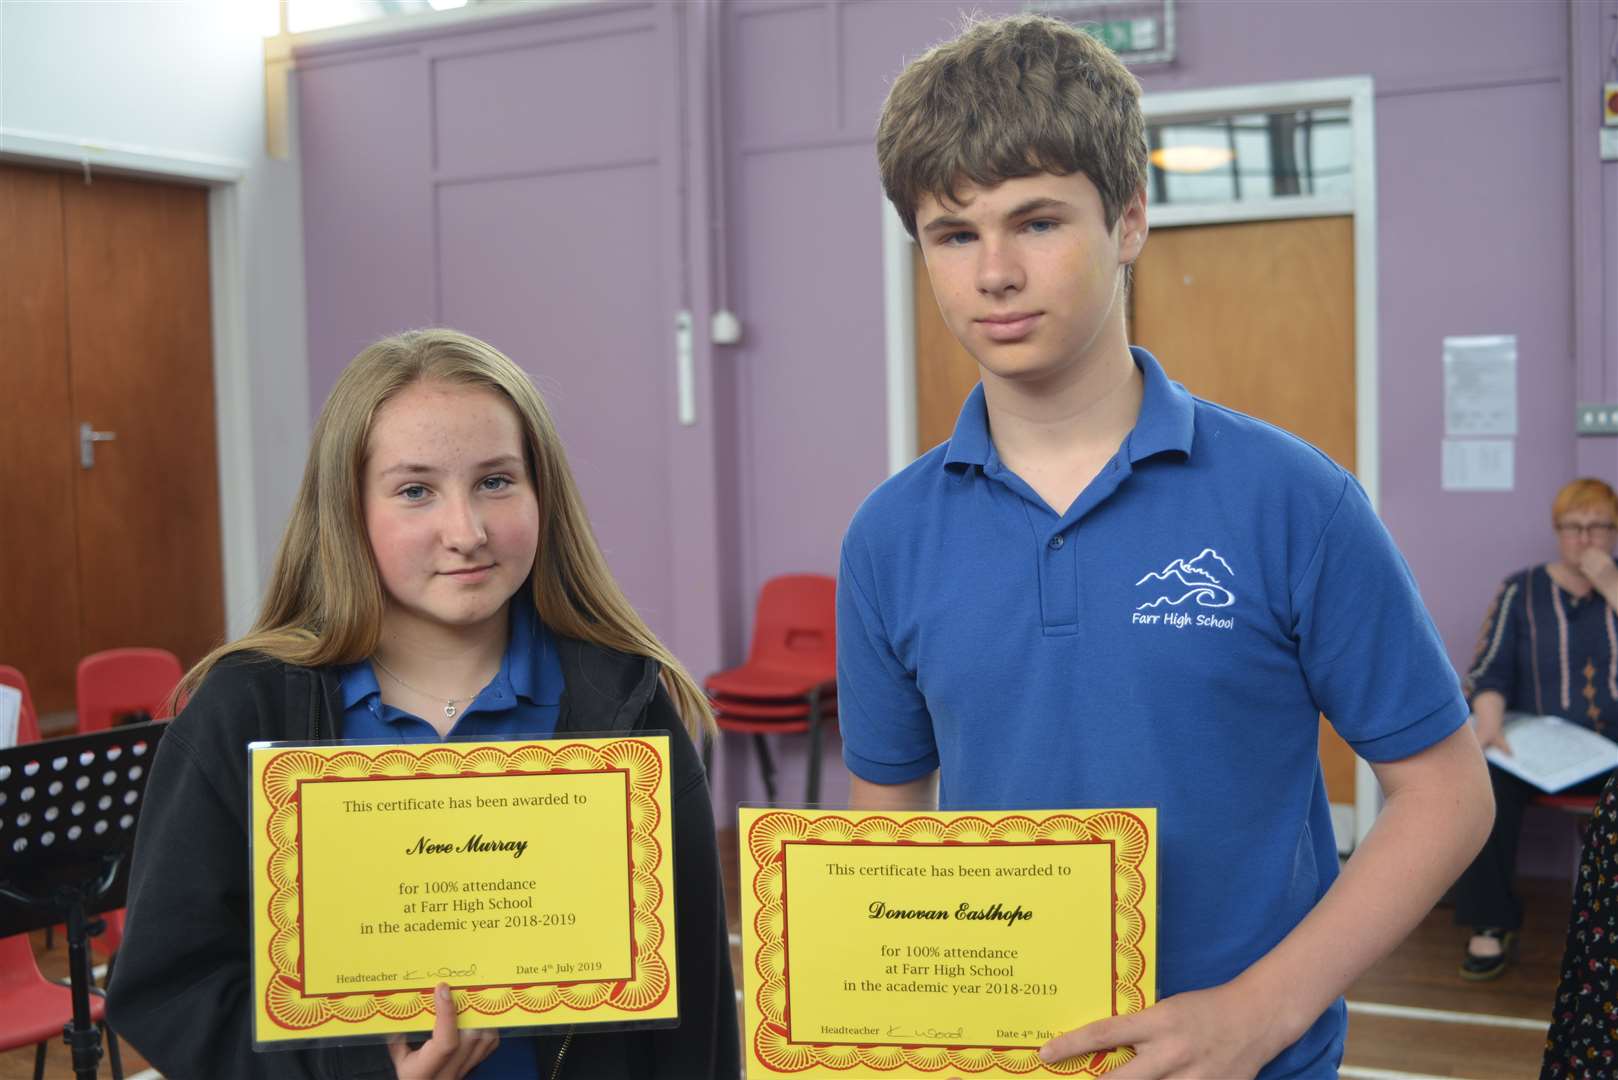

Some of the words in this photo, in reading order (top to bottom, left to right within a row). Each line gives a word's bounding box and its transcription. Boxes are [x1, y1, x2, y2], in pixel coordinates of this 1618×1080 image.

[1132, 612, 1161, 624] Farr
[1163, 612, 1192, 629] High
[1195, 614, 1234, 629] School
[342, 799, 373, 813] This
[376, 798, 445, 812] certificate
[448, 796, 472, 809] has
[476, 795, 508, 808] been
[512, 792, 569, 807] awarded
[573, 793, 587, 805] to
[405, 835, 454, 856] Neve
[455, 833, 528, 859] Murray
[825, 863, 856, 876] This
[859, 863, 927, 877] certificate
[931, 864, 955, 877] has
[958, 864, 991, 878] been
[995, 863, 1053, 877] awarded
[1057, 865, 1072, 876] to
[399, 882, 420, 895] for
[425, 880, 459, 894] 100%
[462, 878, 537, 893] attendance
[403, 902, 417, 914] at
[420, 900, 449, 913] Farr
[453, 898, 485, 914] High
[488, 895, 533, 910] School
[868, 901, 950, 921] Donovan
[954, 902, 1033, 927] Easthope
[360, 922, 374, 935] in
[378, 921, 400, 934] the
[403, 918, 468, 933] academic
[471, 919, 501, 932] year
[504, 913, 576, 928] 2018-2019
[880, 944, 902, 958] for
[907, 945, 941, 958] 100%
[943, 946, 1019, 959] attendance
[516, 965, 539, 975] Date
[555, 962, 575, 975] July
[577, 961, 603, 972] 2019
[885, 964, 898, 975] at
[902, 963, 930, 976] Farr
[934, 963, 966, 978] High
[969, 964, 1014, 977] School
[336, 971, 398, 985] Headteacher
[843, 979, 857, 992] in
[860, 979, 882, 992] the
[886, 980, 949, 993] academic
[952, 984, 982, 996] year
[985, 982, 1058, 996] 2018-2019
[820, 1025, 880, 1036] Headteacher
[996, 1029, 1020, 1039] Date
[1035, 1030, 1056, 1041] July
